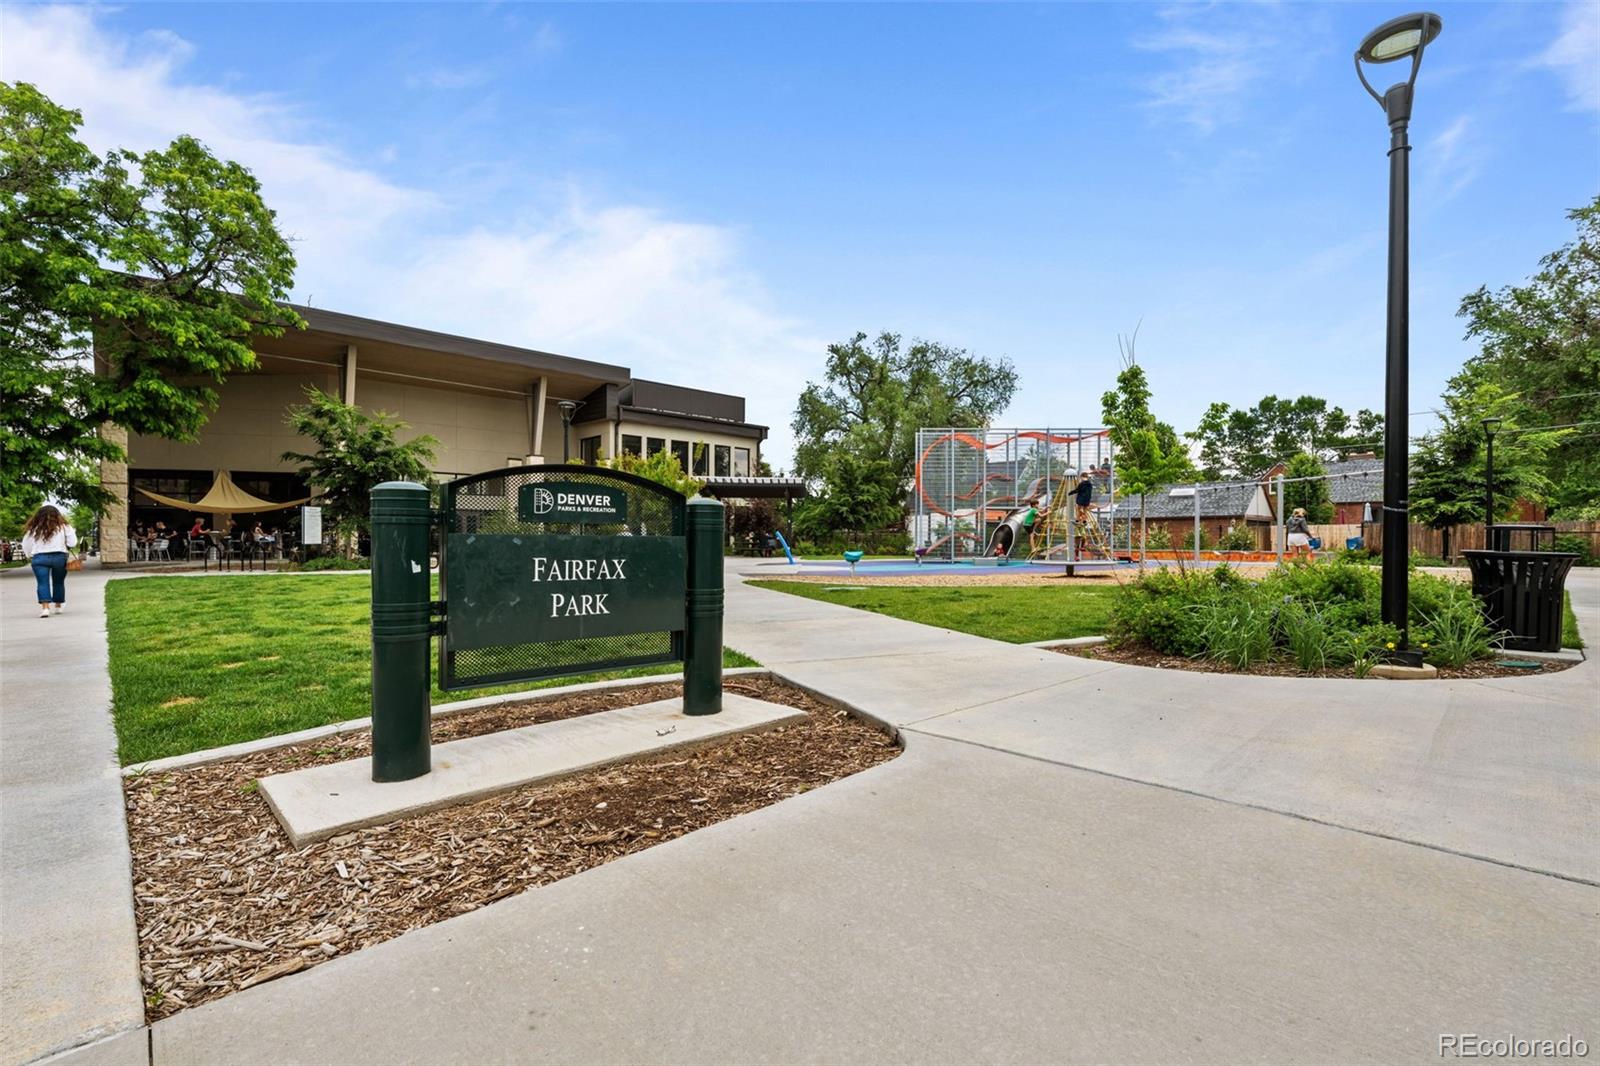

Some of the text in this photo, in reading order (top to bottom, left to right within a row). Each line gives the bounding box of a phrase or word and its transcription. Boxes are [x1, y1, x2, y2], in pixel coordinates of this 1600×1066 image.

[557, 493, 611, 506] DENVER
[532, 557, 627, 582] FAIRFAX
[550, 593, 611, 618] PARK
